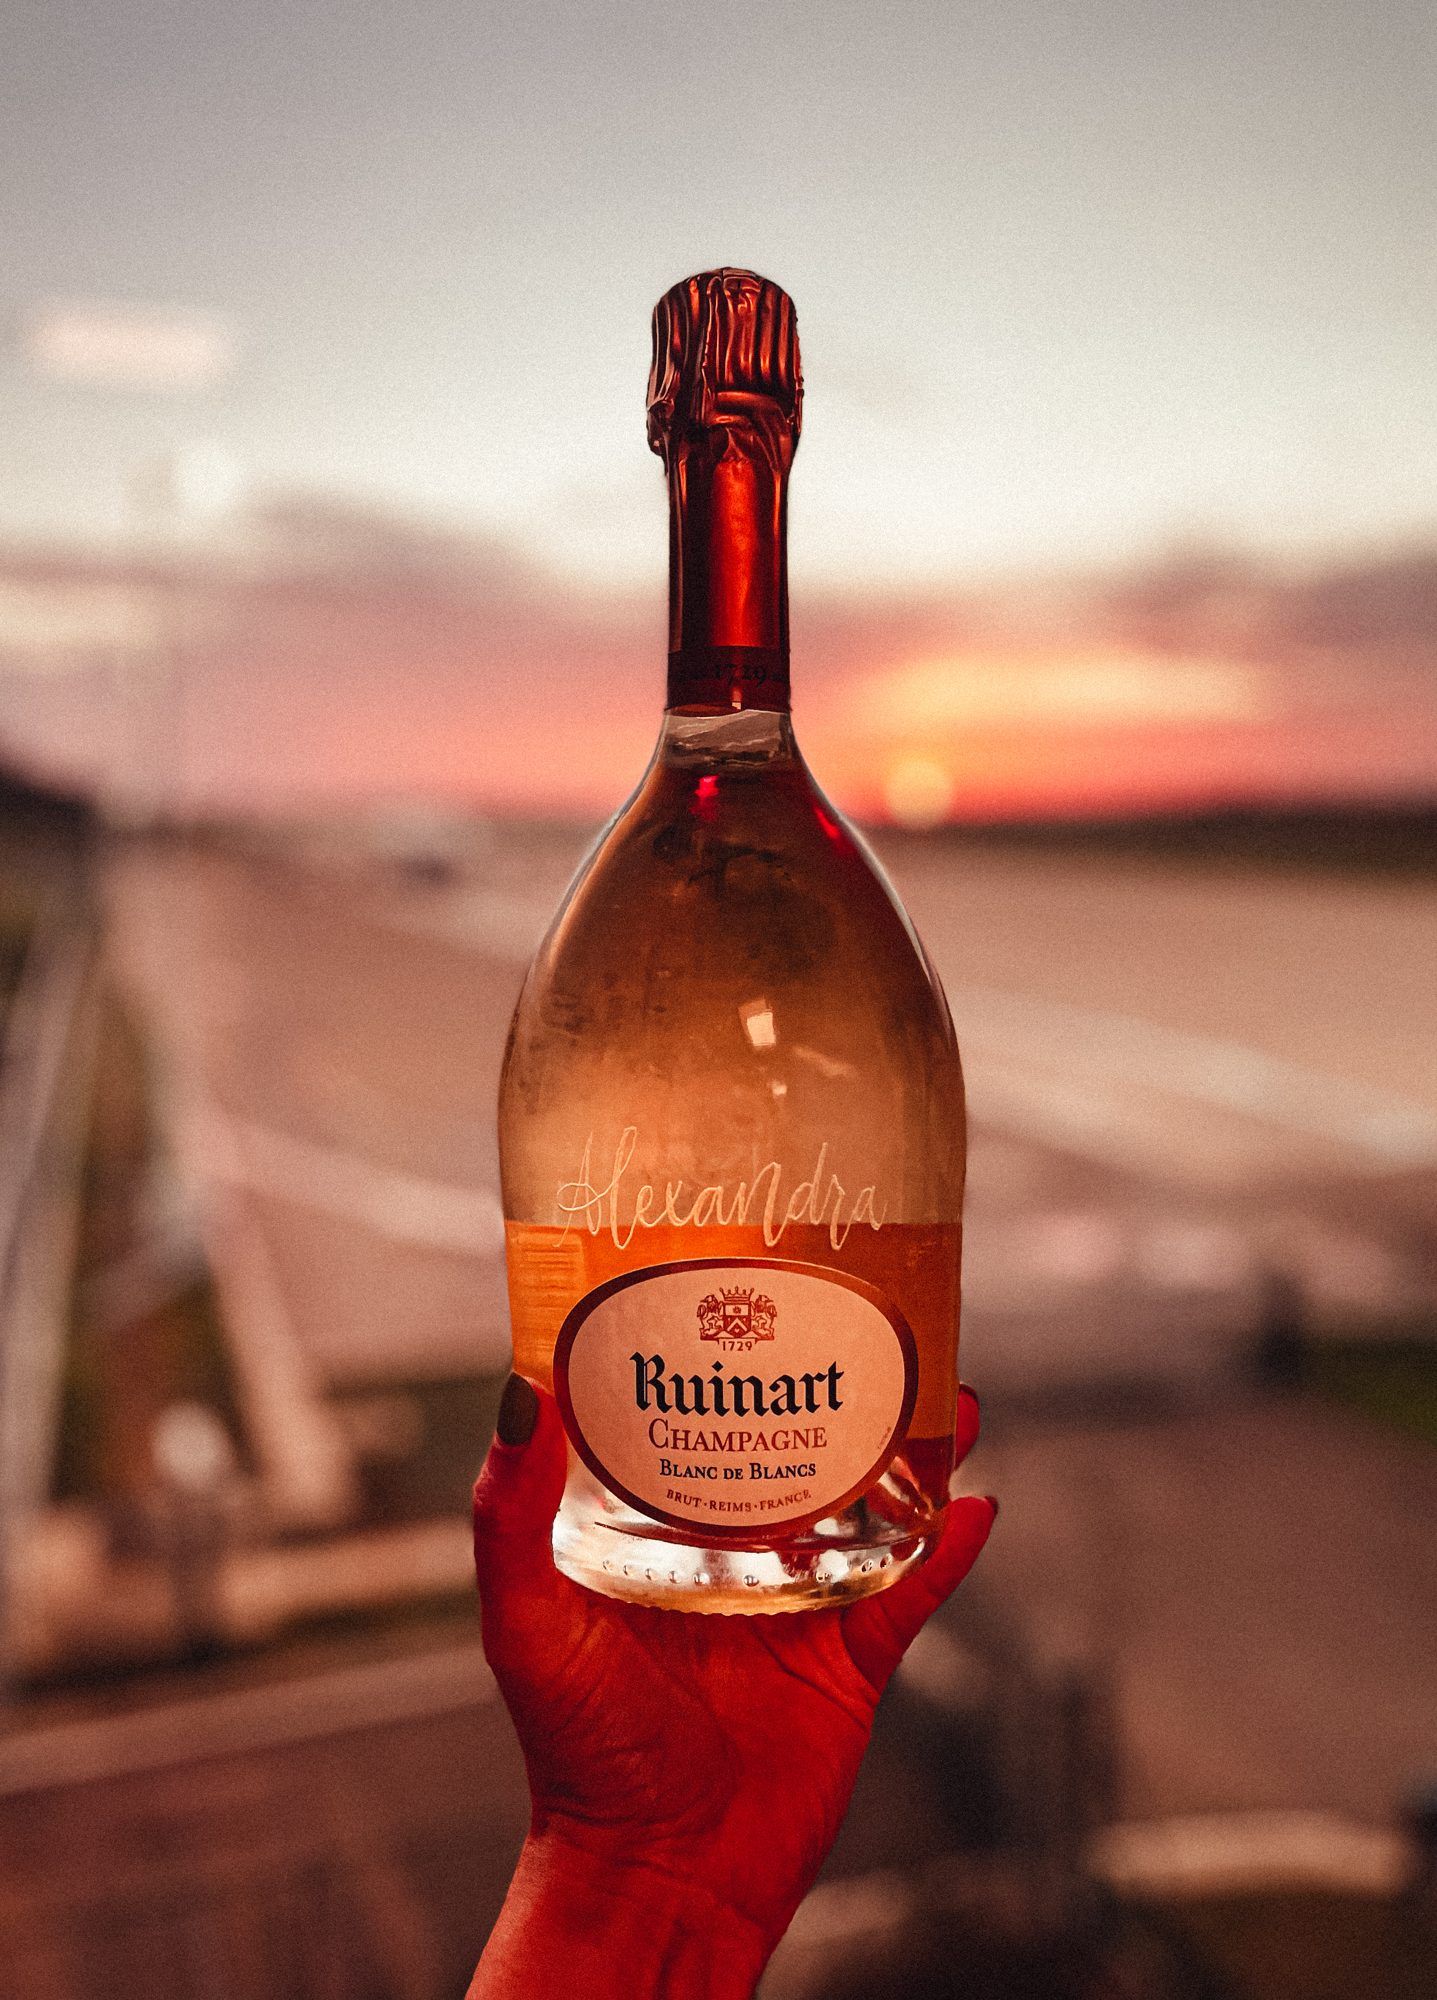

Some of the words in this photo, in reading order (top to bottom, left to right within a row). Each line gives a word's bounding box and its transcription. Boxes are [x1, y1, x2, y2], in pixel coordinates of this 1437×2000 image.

[722, 1340, 753, 1352] 1729
[629, 1352, 845, 1417] Ruinart
[648, 1418, 828, 1452] CHAMPAGNE
[659, 1458, 718, 1480] BLANC
[723, 1467, 744, 1480] DE
[749, 1462, 817, 1480] BLANCS
